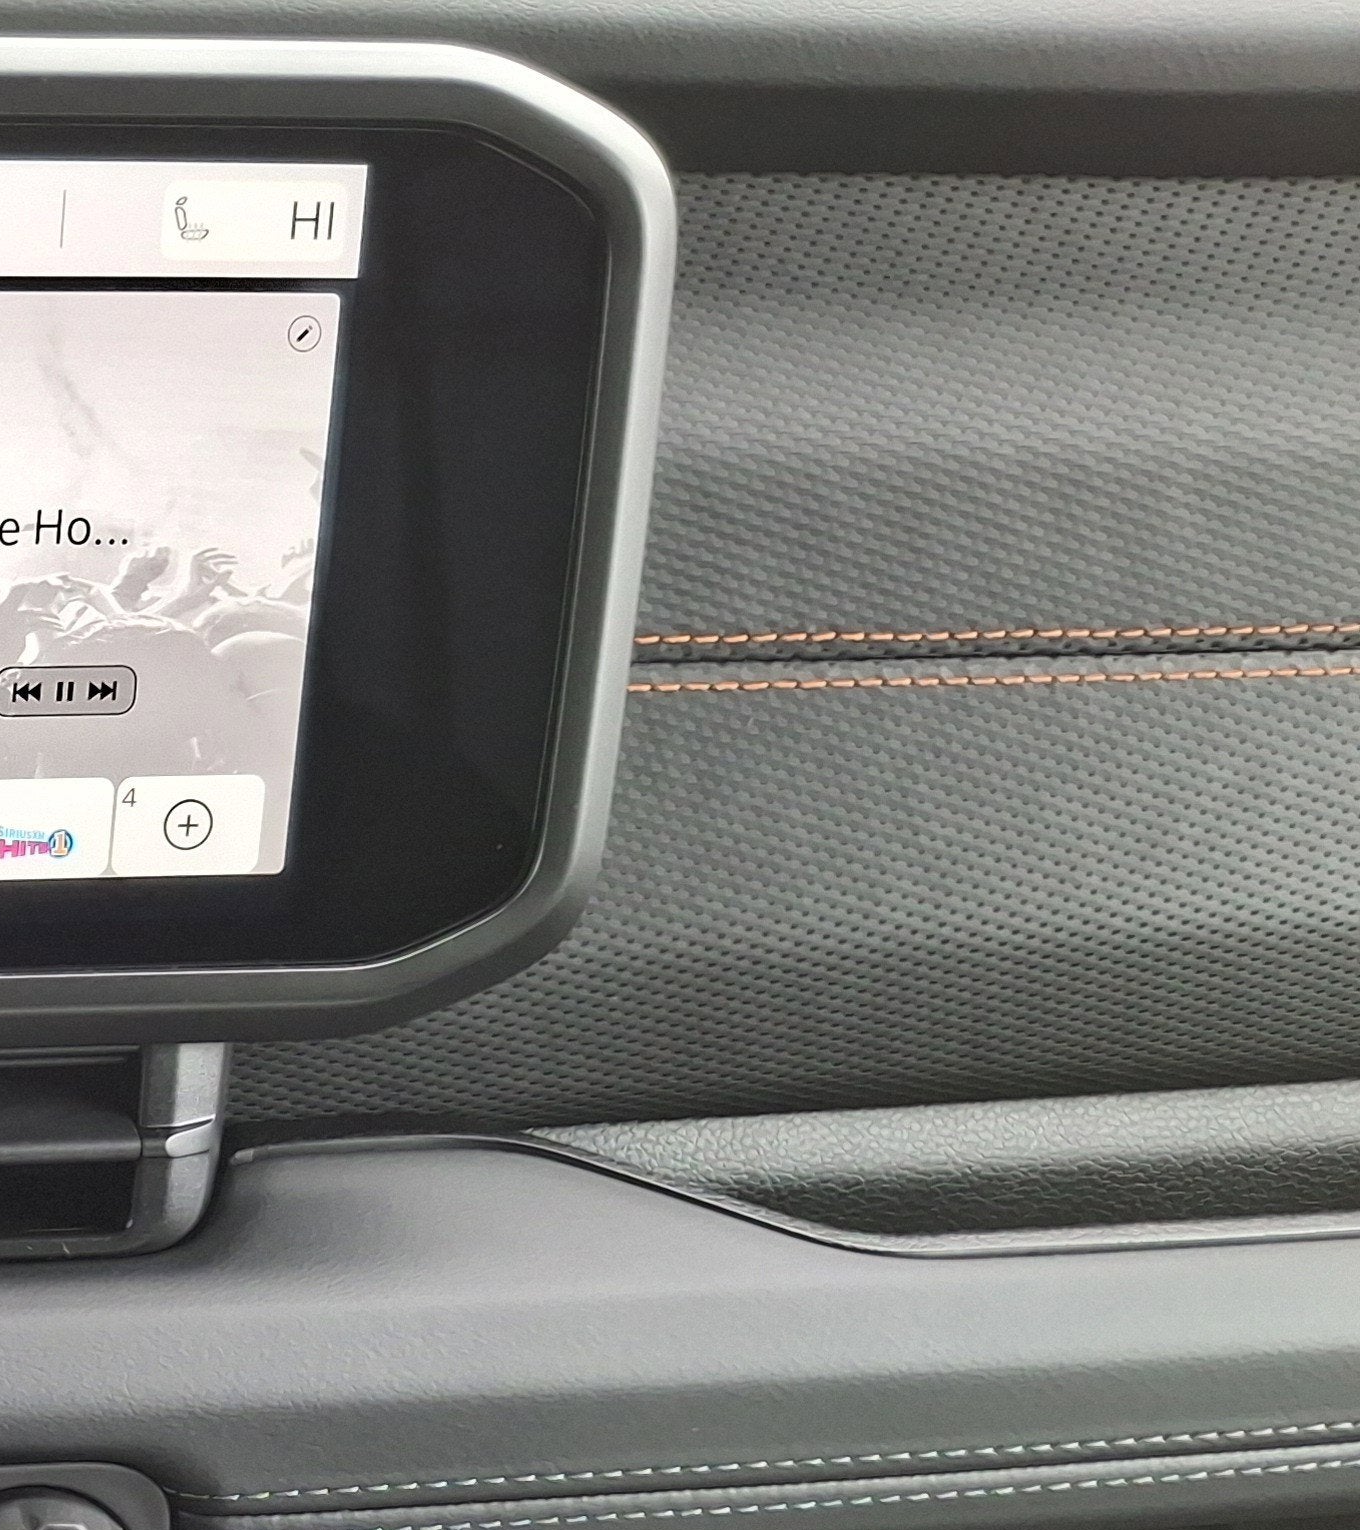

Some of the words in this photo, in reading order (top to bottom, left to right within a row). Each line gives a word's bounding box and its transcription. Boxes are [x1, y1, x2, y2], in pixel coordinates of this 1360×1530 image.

[290, 201, 335, 240] HI
[34, 508, 131, 548] Ho...
[122, 787, 137, 808] 4
